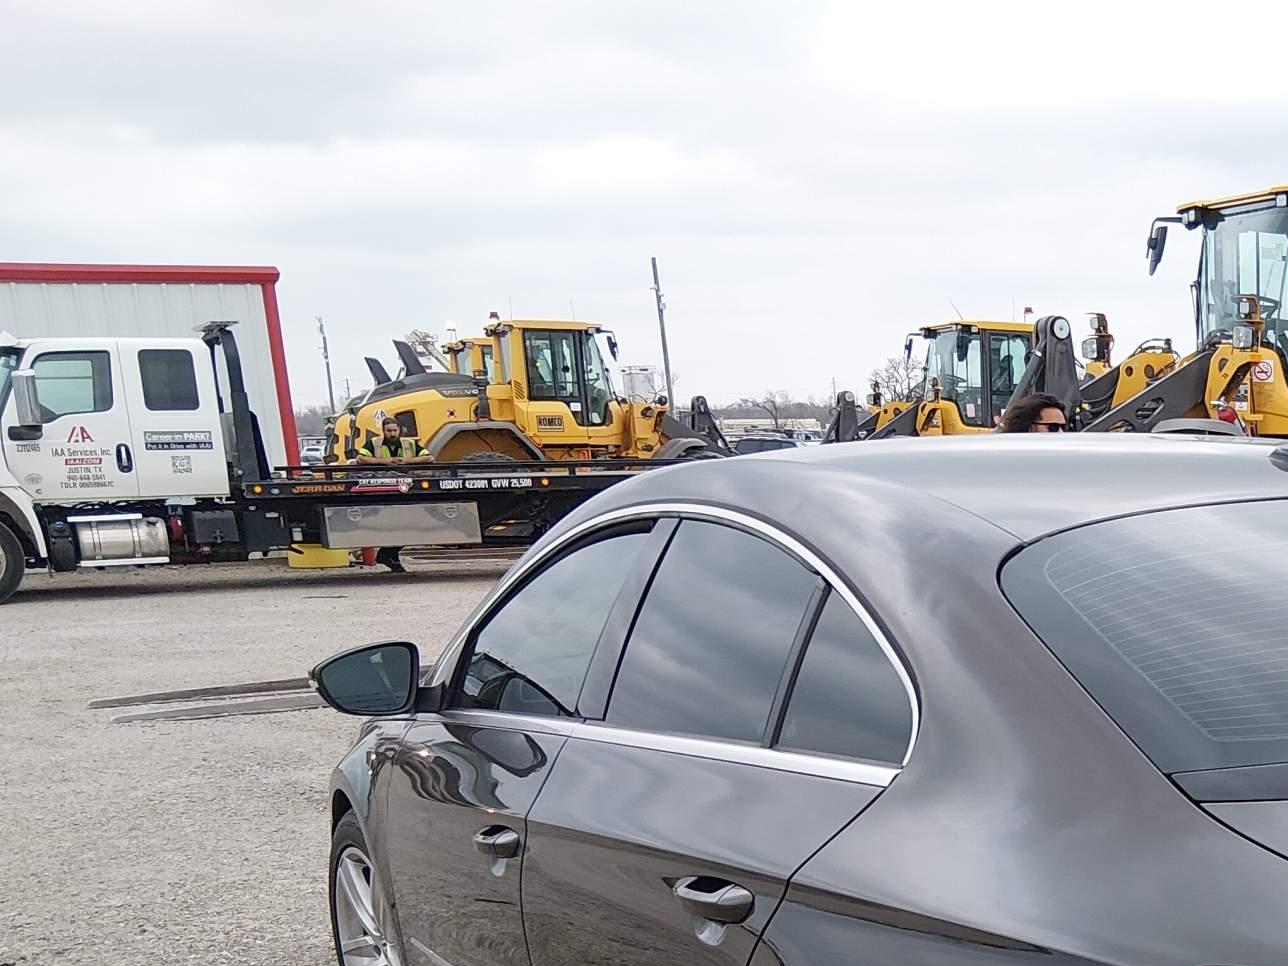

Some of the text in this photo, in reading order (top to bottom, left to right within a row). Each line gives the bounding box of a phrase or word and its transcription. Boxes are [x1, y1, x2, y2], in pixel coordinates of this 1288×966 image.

[51, 448, 66, 457] IAA
[100, 447, 112, 456] Inc.
[440, 480, 463, 489] USDOT
[491, 479, 509, 488] GVW
[510, 478, 533, 488] 25,500
